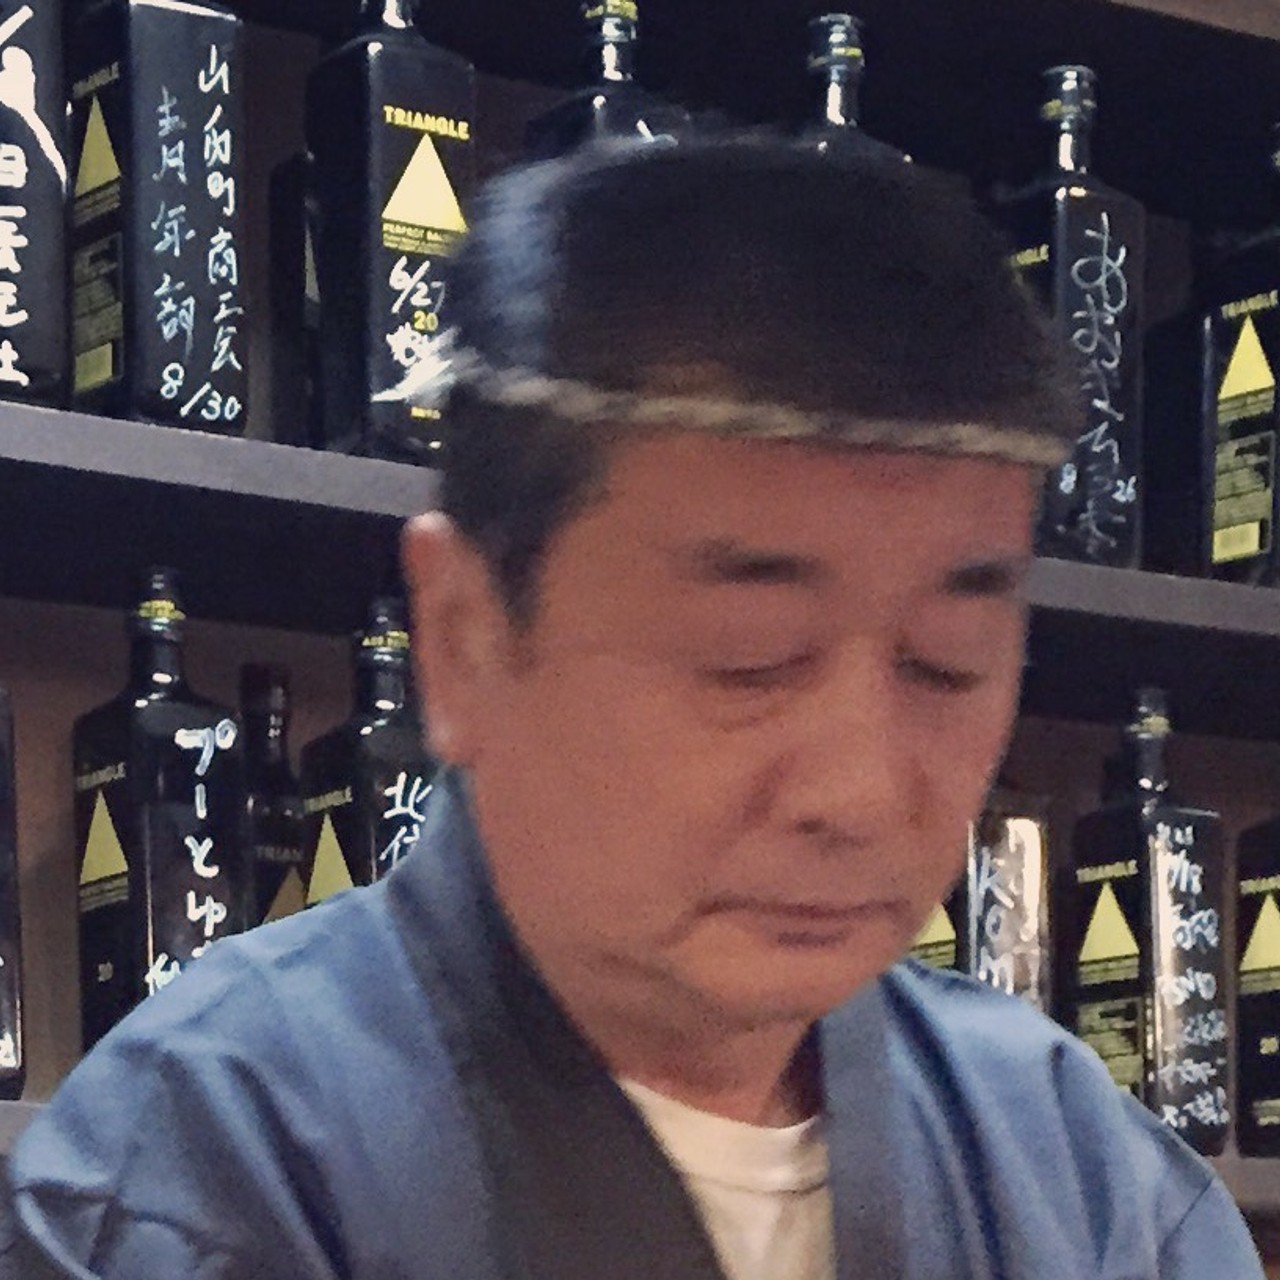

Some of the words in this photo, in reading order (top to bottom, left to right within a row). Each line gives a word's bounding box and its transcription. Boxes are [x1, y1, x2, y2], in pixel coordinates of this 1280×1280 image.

[382, 105, 470, 140] TRIANGLE
[160, 362, 243, 421] 8/30
[174, 718, 238, 958] プーとゆ
